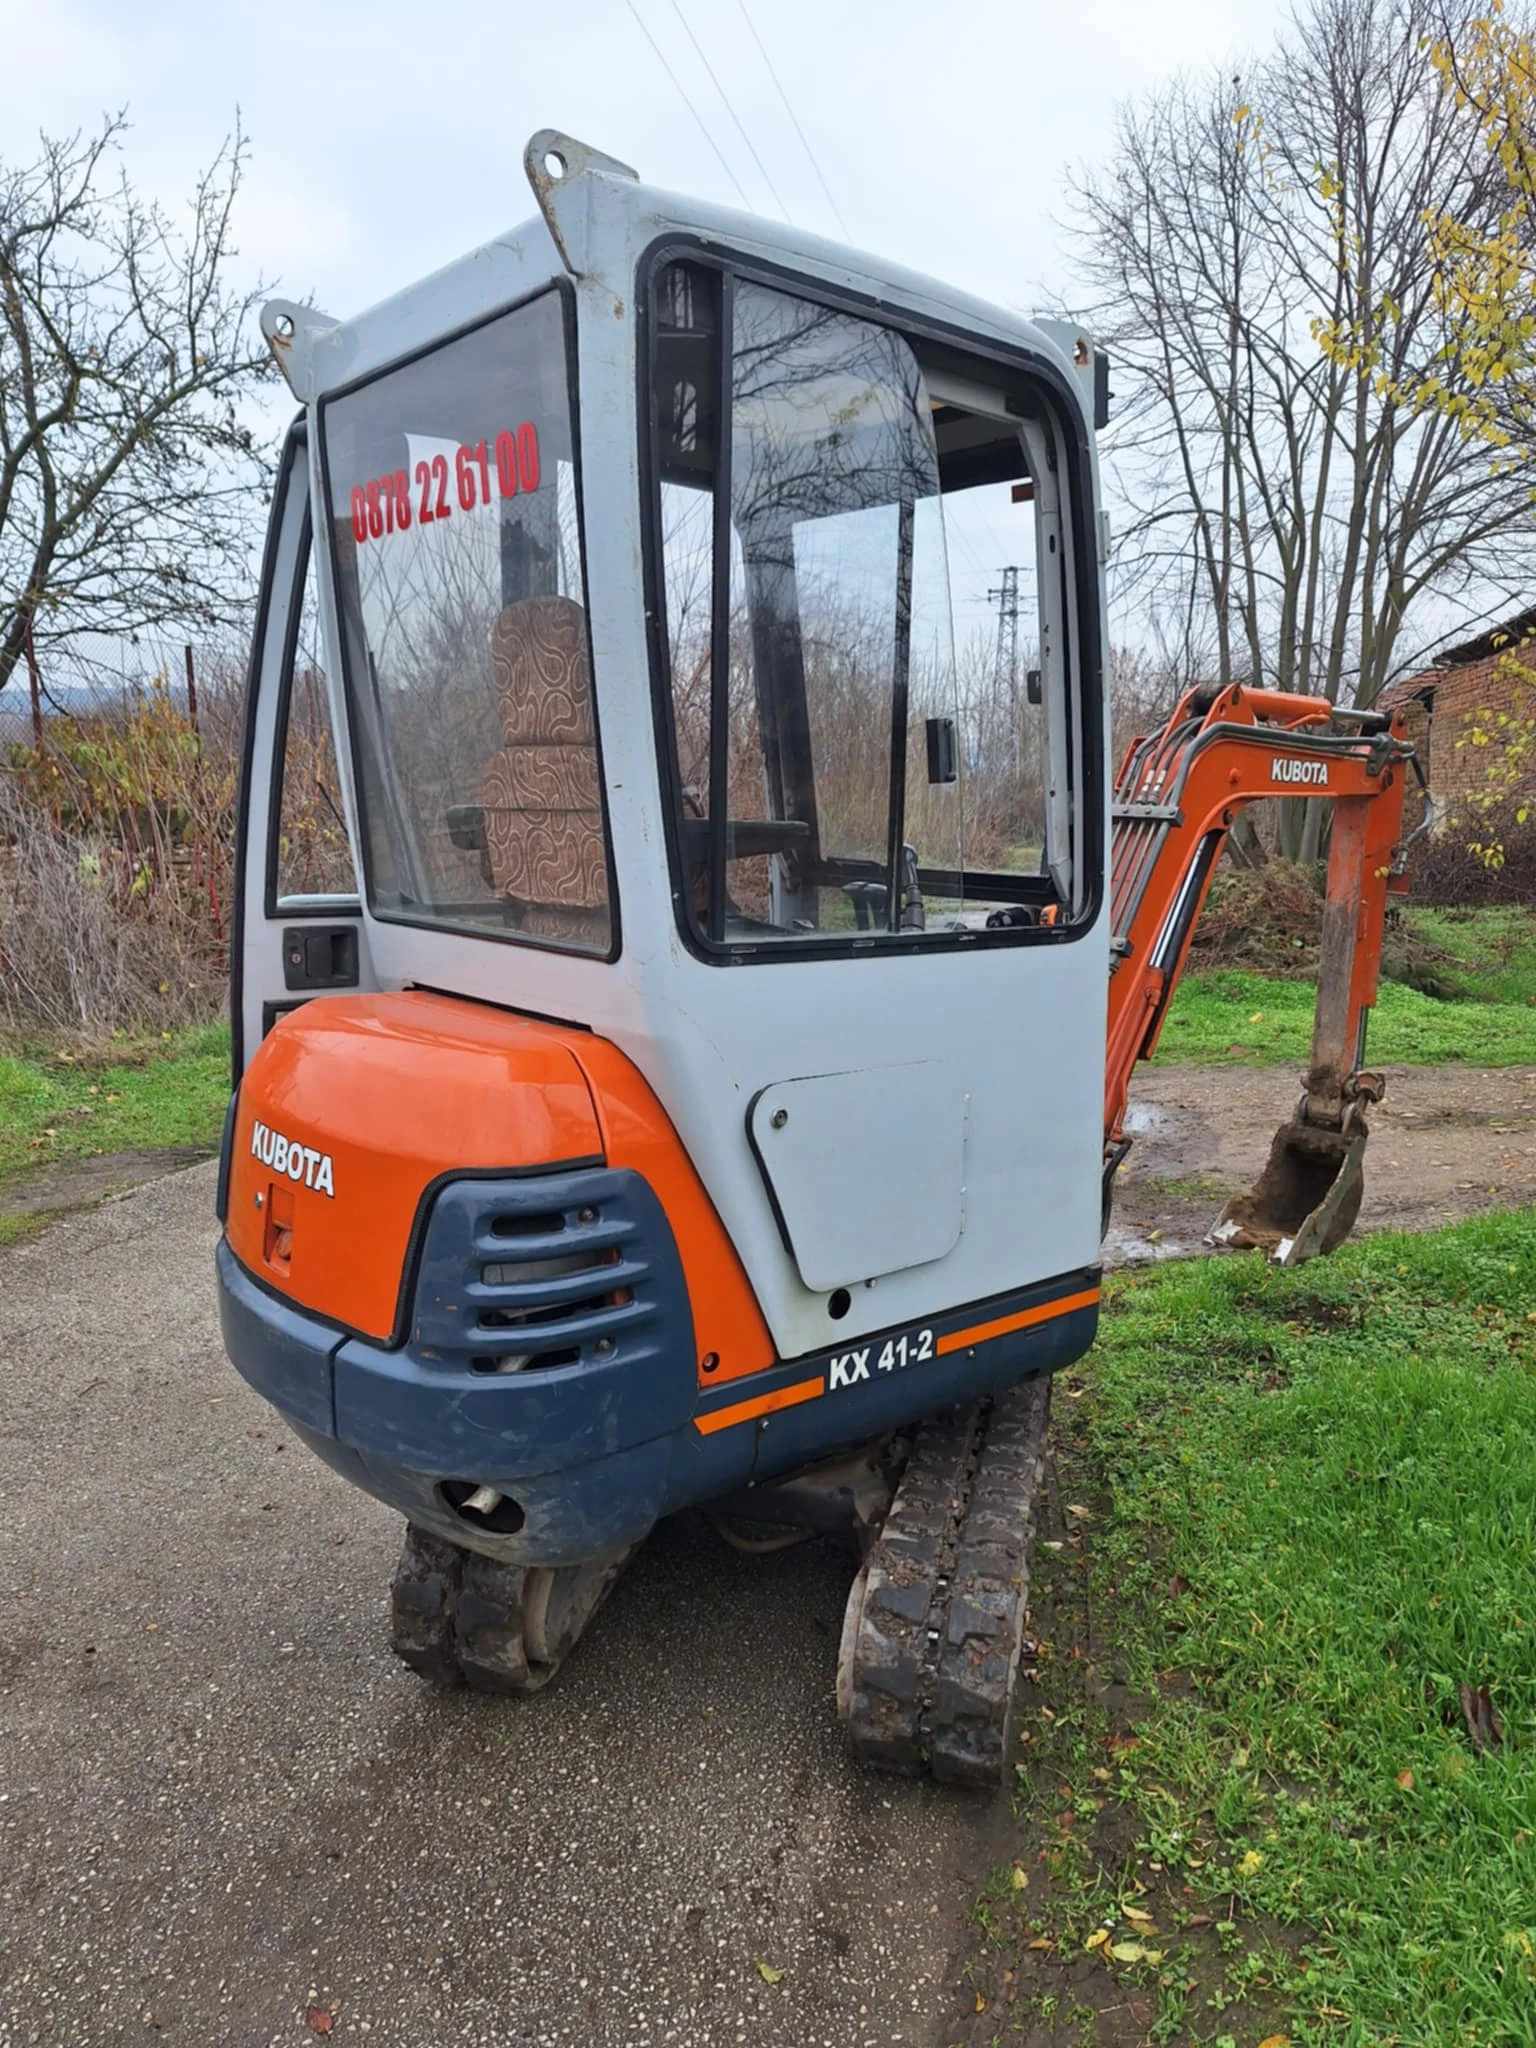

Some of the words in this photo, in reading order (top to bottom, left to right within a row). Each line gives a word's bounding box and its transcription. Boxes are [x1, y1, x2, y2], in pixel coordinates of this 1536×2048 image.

[351, 469, 412, 544] 0878
[415, 454, 452, 525] 22
[456, 439, 491, 512] 61
[496, 421, 541, 500] 00
[1271, 758, 1329, 785] KUBOTA
[251, 1120, 335, 1198] KUBOTA
[829, 1347, 871, 1391] KX
[877, 1329, 933, 1372] 41-2
